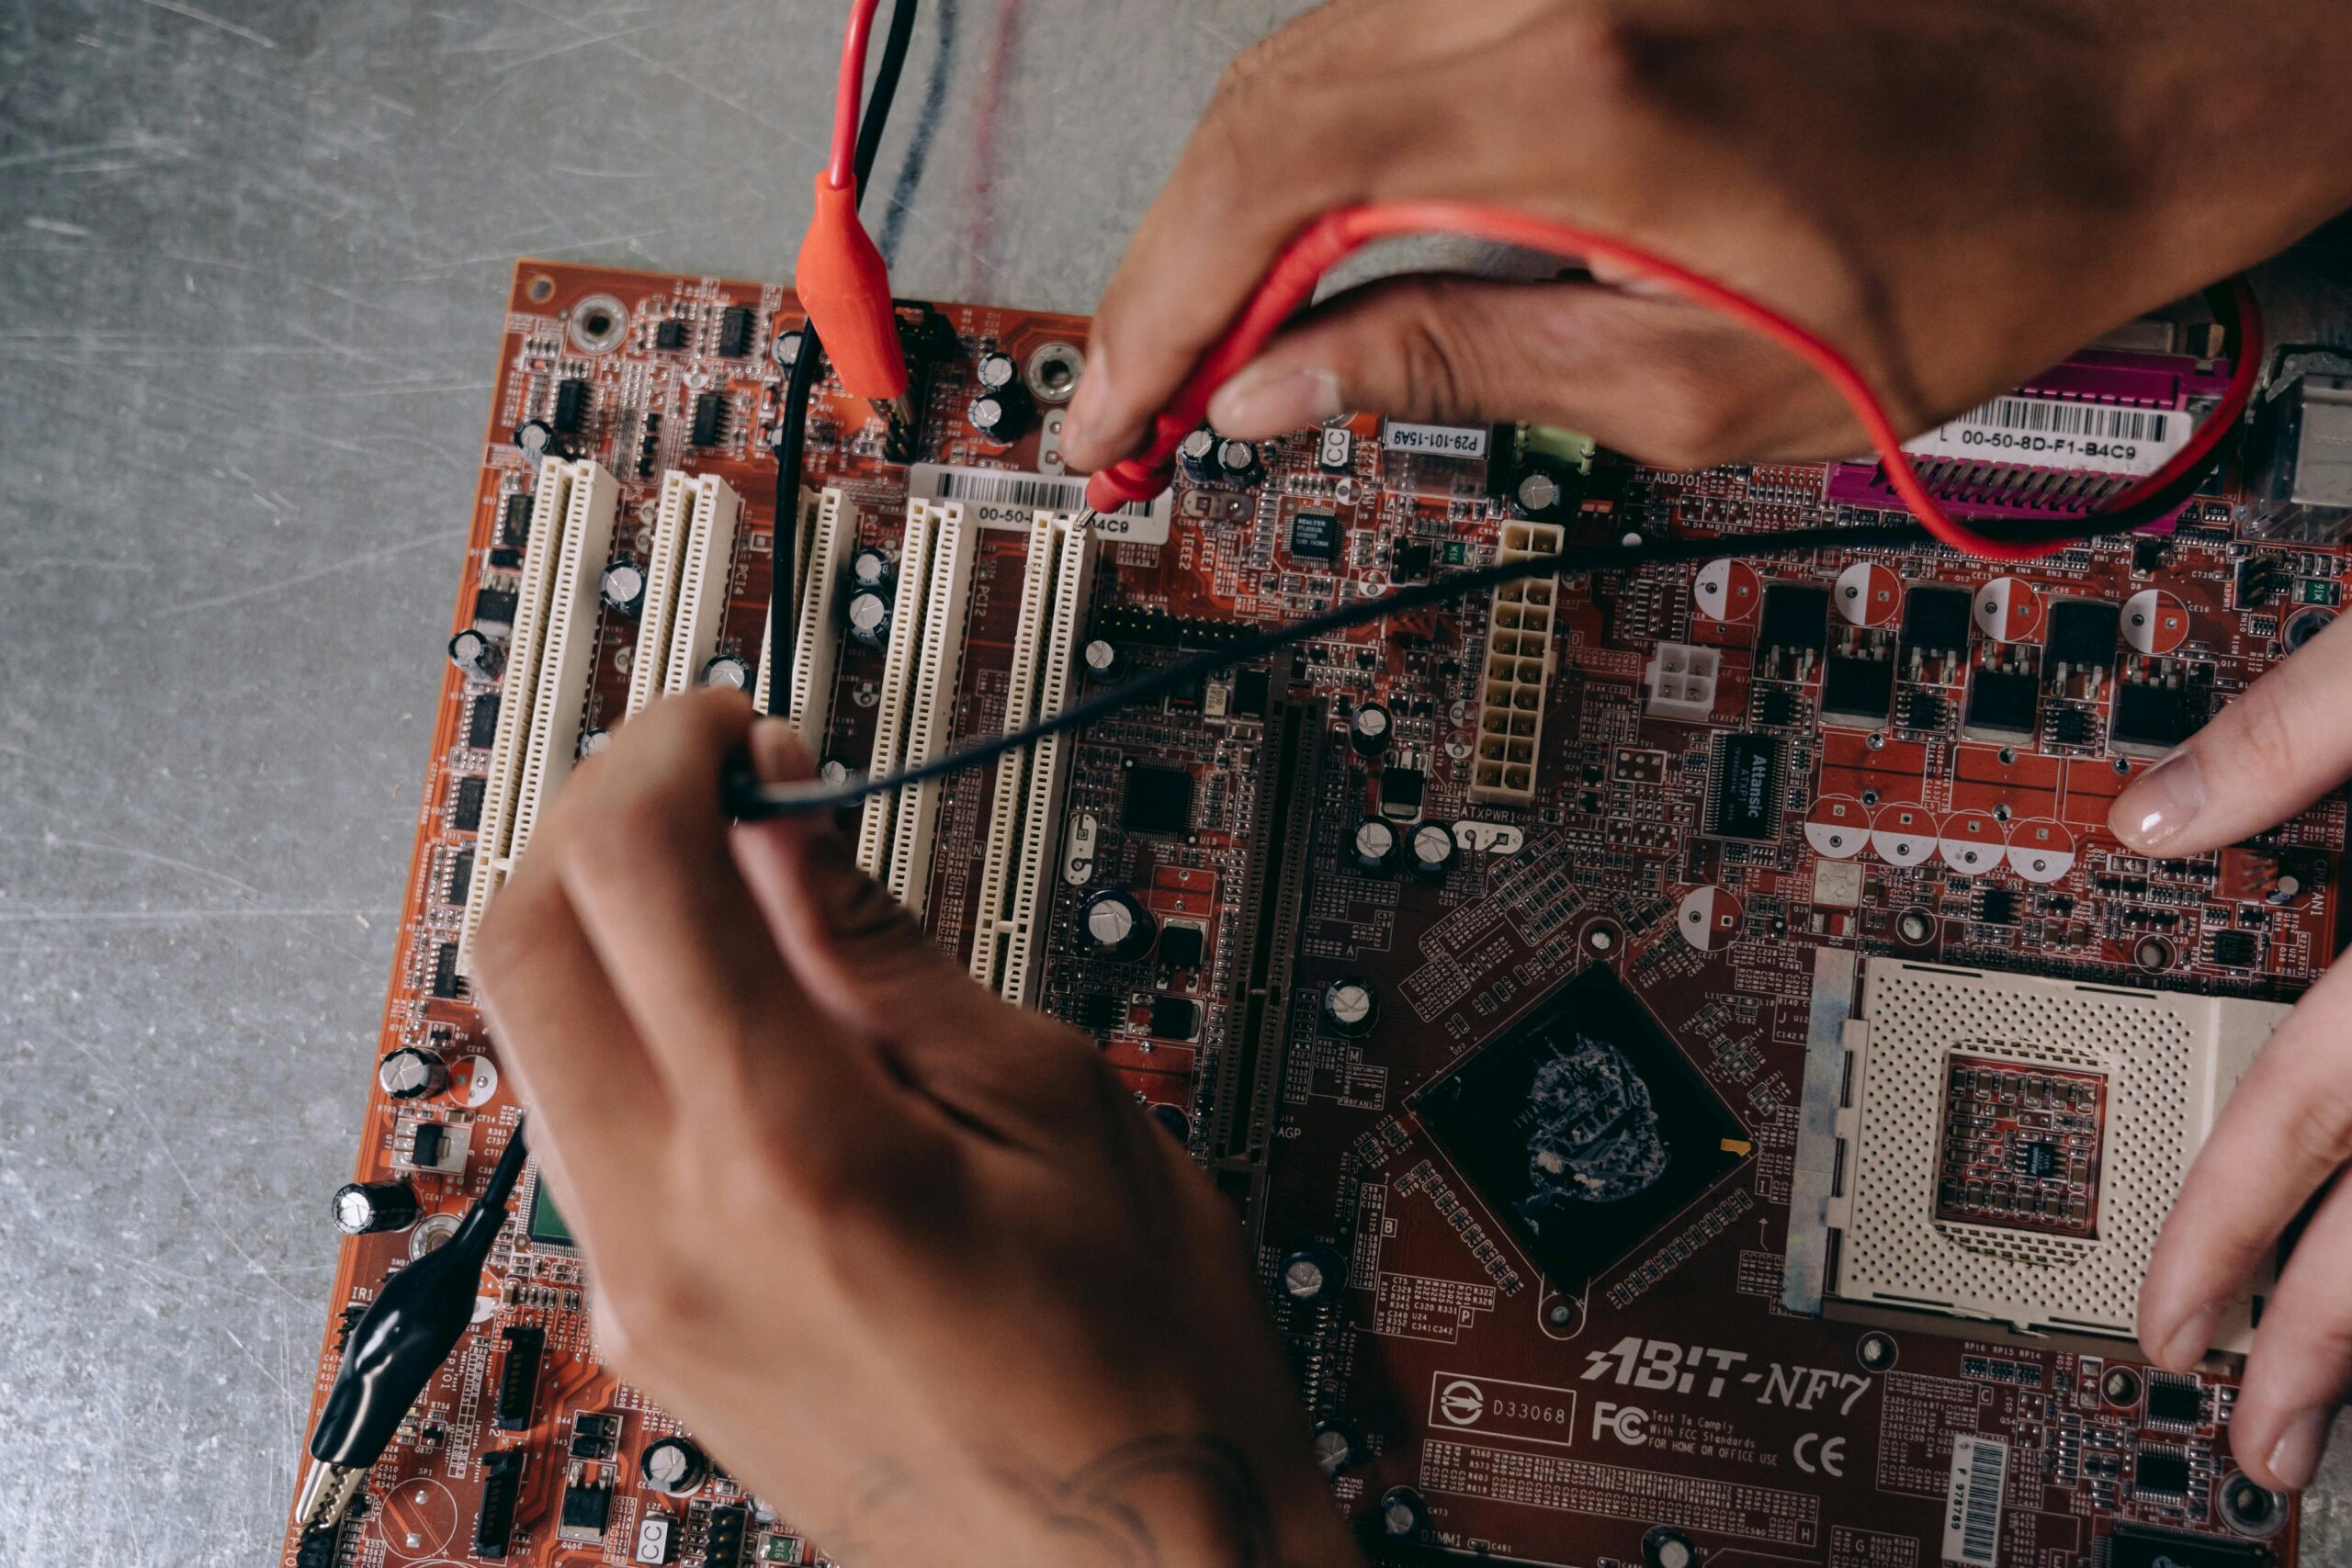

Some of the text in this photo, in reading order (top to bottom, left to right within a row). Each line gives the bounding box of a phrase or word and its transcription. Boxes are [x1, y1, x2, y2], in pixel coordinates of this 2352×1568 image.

[1394, 430, 1476, 451] P29-101-15A9
[1962, 430, 2136, 459] 00-50-8D-F1-B4C9
[1654, 472, 1700, 487] AUDIO1
[1748, 754, 1767, 818] Attansic
[1461, 807, 1516, 822] ATXPWR1
[973, 844, 983, 856] N
[1779, 1012, 1786, 1023] J
[1350, 1050, 1359, 1062] M
[1277, 1128, 1301, 1139] AGP
[1385, 1222, 1394, 1234] B
[352, 1287, 373, 1301] IR1
[1462, 1311, 1470, 1322] P
[1981, 1390, 1990, 1403] C
[1494, 1398, 1566, 1424] D33068
[1652, 1410, 1734, 1434] Test To Comply
[1650, 1424, 1756, 1449] With FCC Standards
[1648, 1437, 1778, 1466] FOR HOME OR OFFICE USE
[1801, 1528, 1810, 1540] H
[1855, 1539, 1865, 1552] G
